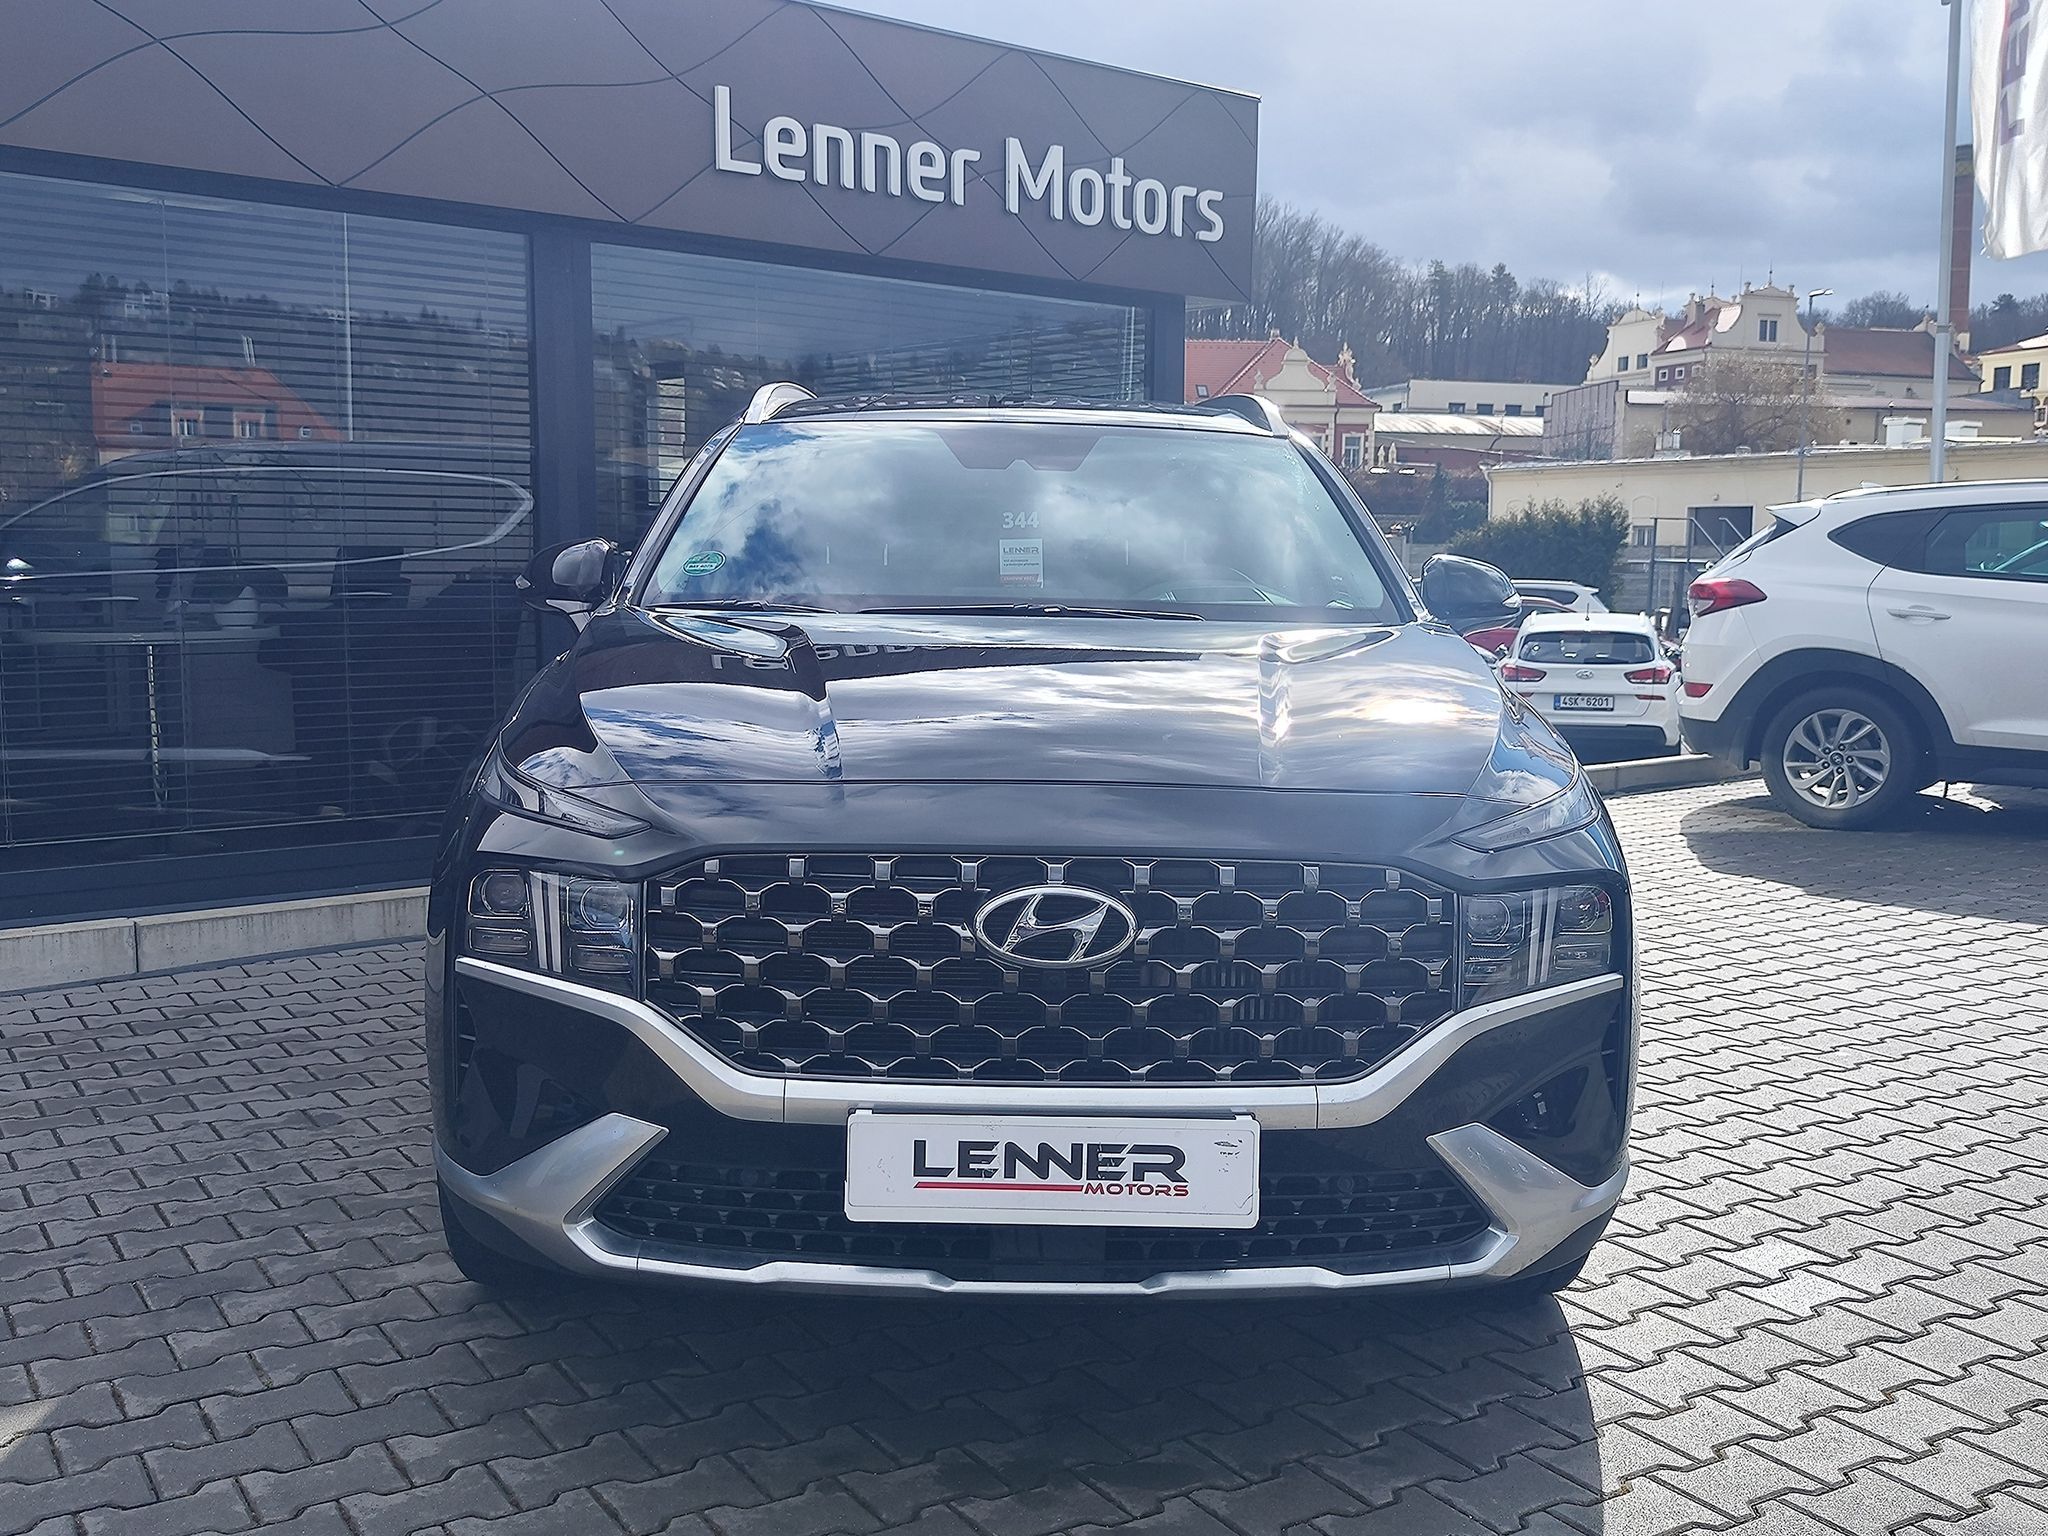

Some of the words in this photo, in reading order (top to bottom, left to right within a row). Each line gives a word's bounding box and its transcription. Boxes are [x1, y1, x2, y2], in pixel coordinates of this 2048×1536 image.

[713, 84, 981, 206] Lenner
[1005, 136, 1225, 242] Motors
[1002, 511, 1040, 529] 344
[1562, 697, 1579, 707] 4SK
[1585, 697, 1610, 707] 6201
[913, 1139, 1190, 1183] LENNER
[1084, 1182, 1189, 1198] MOTORS
